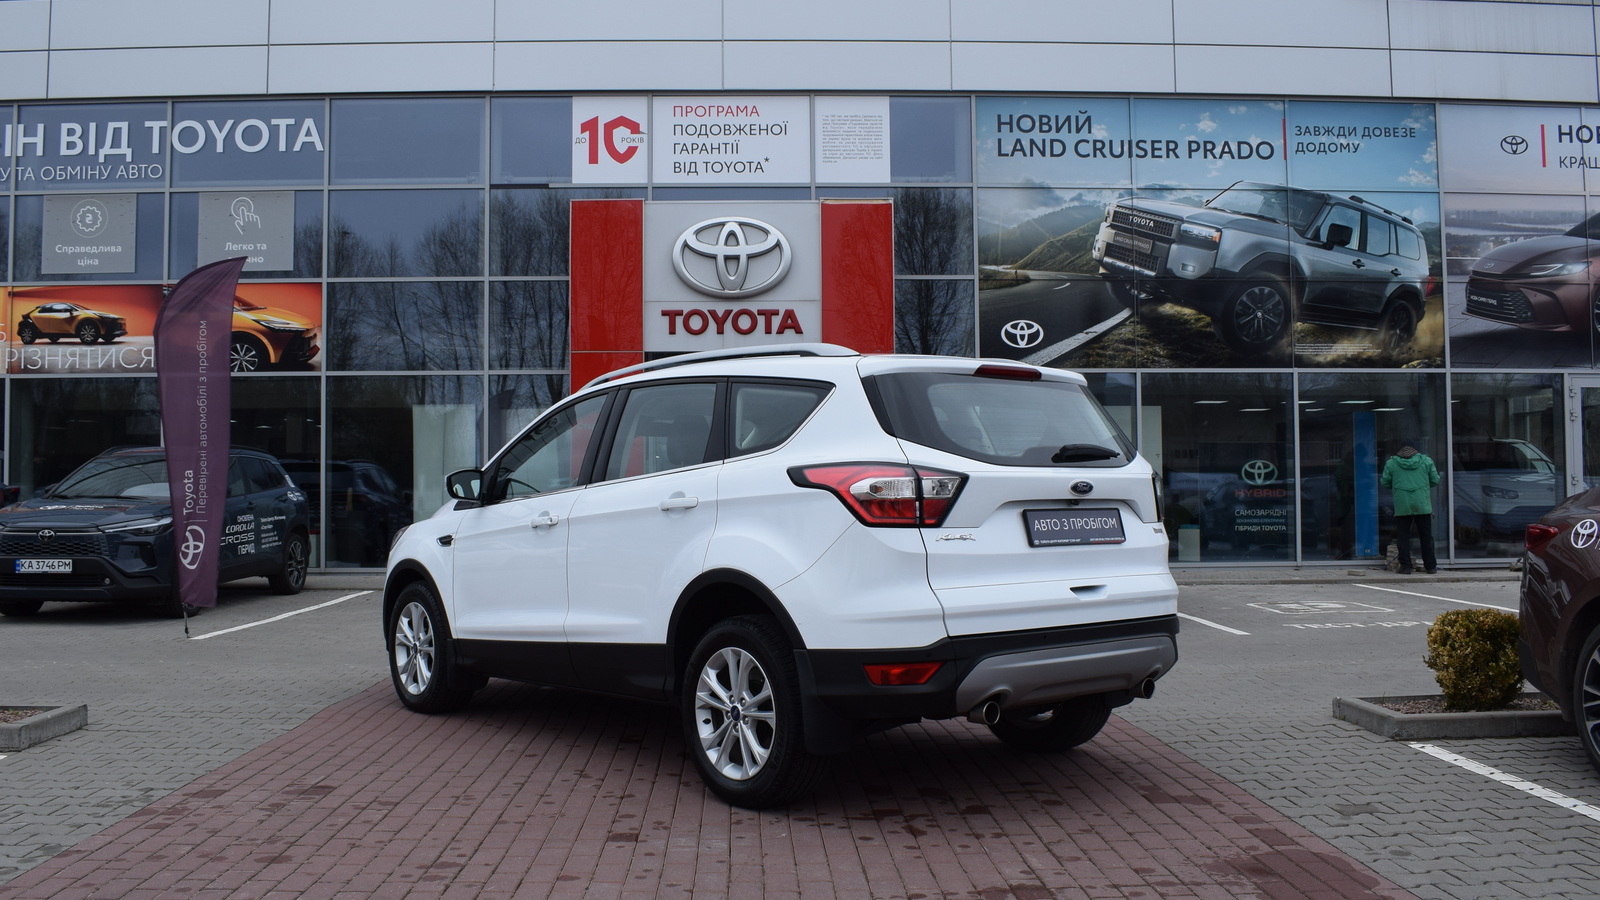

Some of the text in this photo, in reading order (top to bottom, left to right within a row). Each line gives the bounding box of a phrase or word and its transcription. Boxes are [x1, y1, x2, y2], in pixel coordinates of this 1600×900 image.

[673, 105, 760, 118] ПРОГРАМА
[673, 120, 789, 139] ПОДОВЖЕНОЇ
[997, 110, 1093, 134] НОВИЙ
[1294, 125, 1416, 139] ЗАВЖДИ ДОВЕЗЕ
[60, 121, 133, 163] ВІД
[144, 118, 324, 154] TOYOTA
[575, 137, 587, 145] ДО
[580, 115, 641, 165] 10
[673, 139, 740, 155] ГАРАНТІЇ
[997, 138, 1275, 161] LAND CRUISER PRADO
[1295, 142, 1361, 155] ДОДОМУ
[16, 166, 35, 181] ТА
[40, 165, 112, 181] ОБМІНУ
[115, 164, 163, 179] АВТО
[673, 161, 699, 176] ВІД
[1129, 215, 1154, 227] TOYOTA
[55, 244, 122, 254] Справедлива
[224, 242, 255, 251] Легко
[77, 256, 99, 267] ціна
[661, 308, 804, 336] TOYOTA
[197, 320, 209, 373] пробігом
[5, 346, 156, 370] РІЗНЯТИСЯ
[196, 385, 208, 447] автомобілі
[195, 450, 209, 514] Перевірені
[183, 469, 197, 516] Toyota
[1235, 489, 1287, 498] HYBRID
[1235, 509, 1287, 517] САМОЗАРЯДНІ
[225, 522, 255, 533] COROLLA
[1034, 518, 1060, 531] АВТО
[1070, 517, 1118, 530] ПРОБІГОМ
[35, 561, 56, 570] 3746
